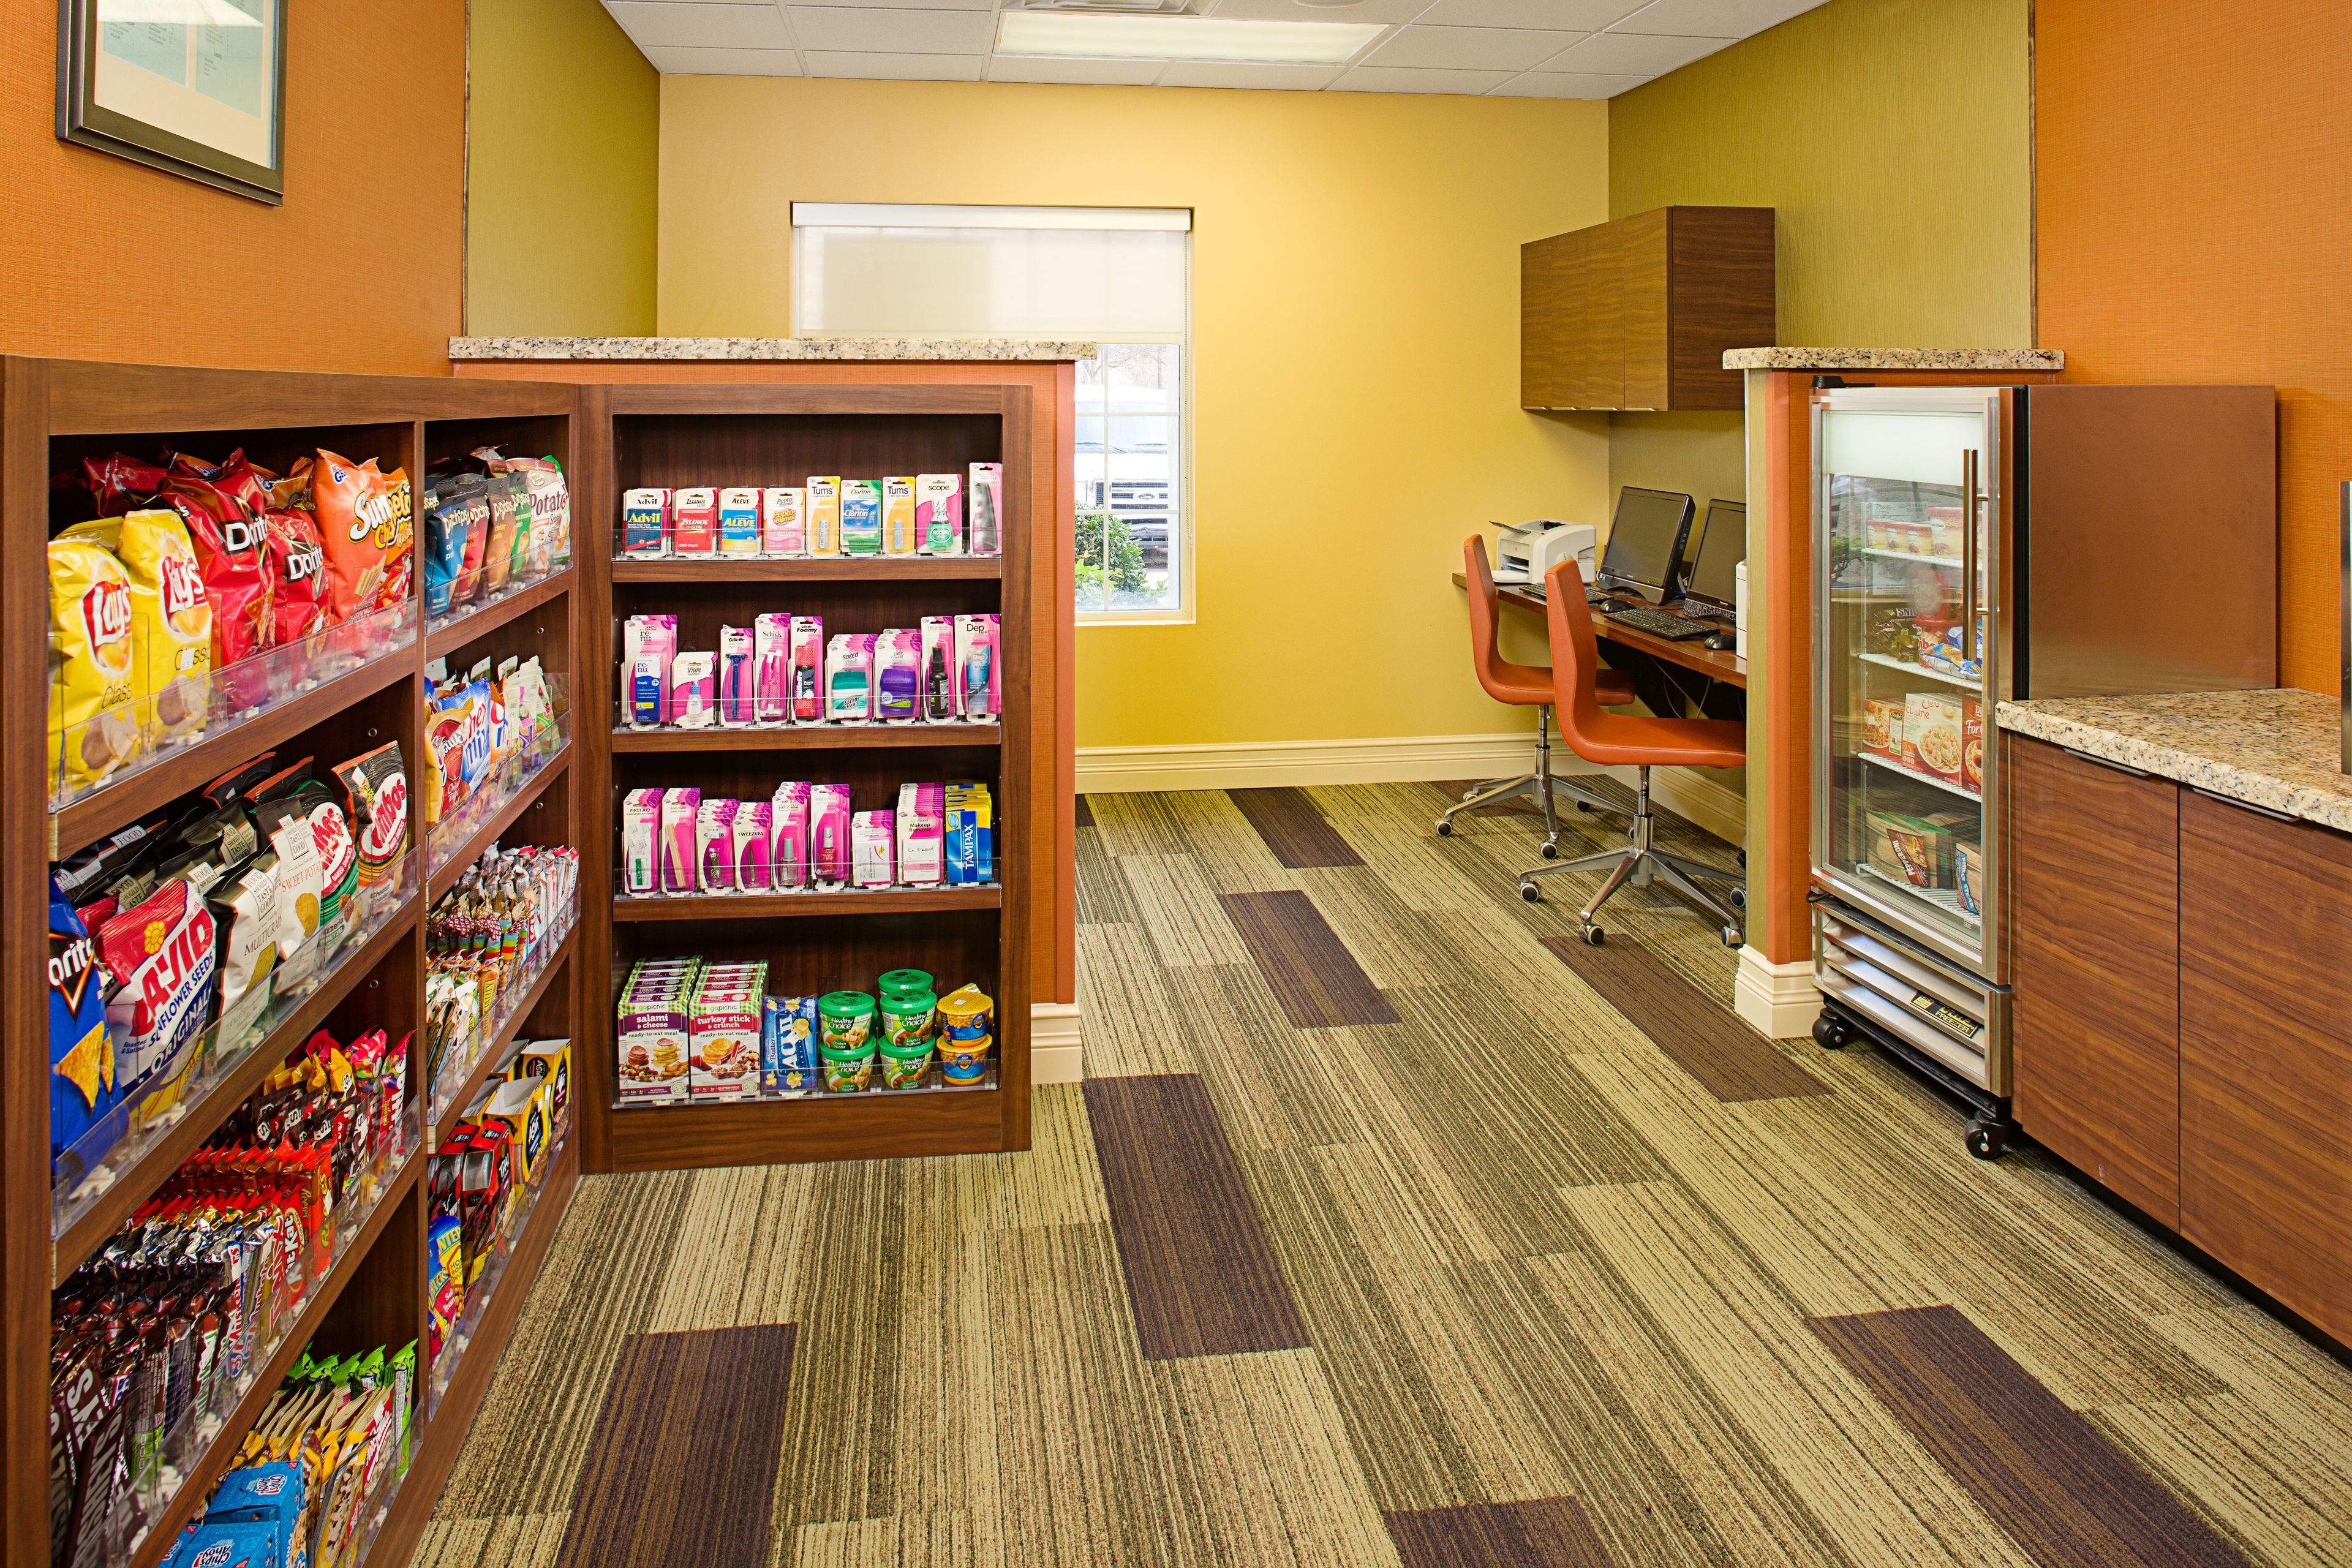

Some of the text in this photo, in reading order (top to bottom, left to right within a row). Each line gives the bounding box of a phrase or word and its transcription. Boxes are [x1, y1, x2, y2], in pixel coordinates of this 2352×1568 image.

[812, 486, 833, 495] Tums
[888, 486, 909, 494] Tums
[628, 513, 662, 523] Advil
[723, 518, 755, 527] ALEVE
[775, 514, 796, 524] Bismol
[225, 516, 268, 552] Dorit
[288, 546, 323, 581] Dorit
[967, 624, 985, 634] Dep
[102, 683, 132, 709] Class
[283, 819, 293, 829] FOOD
[118, 829, 143, 846] FOOD
[289, 834, 303, 845] TASTE
[231, 841, 246, 856] TASTE
[293, 842, 306, 854] GOOD
[965, 824, 974, 870] TAMPAX
[331, 846, 354, 882] BAKED SNACKS
[1892, 839, 1915, 876] PEPPERONI
[194, 865, 212, 881] FOOD
[245, 871, 263, 887] FOOD
[282, 861, 323, 893] SWEET POTAT
[254, 880, 268, 894] SHOULD
[257, 886, 273, 903] TASTE
[260, 895, 273, 914] GOOD
[191, 953, 214, 987] SEEDS
[636, 1013, 669, 1023] salami
[697, 1014, 750, 1025] turkey stick
[1935, 1011, 1970, 1033] FREEZER
[285, 1215, 299, 1251] Kat
[200, 1551, 230, 1566] Chips
